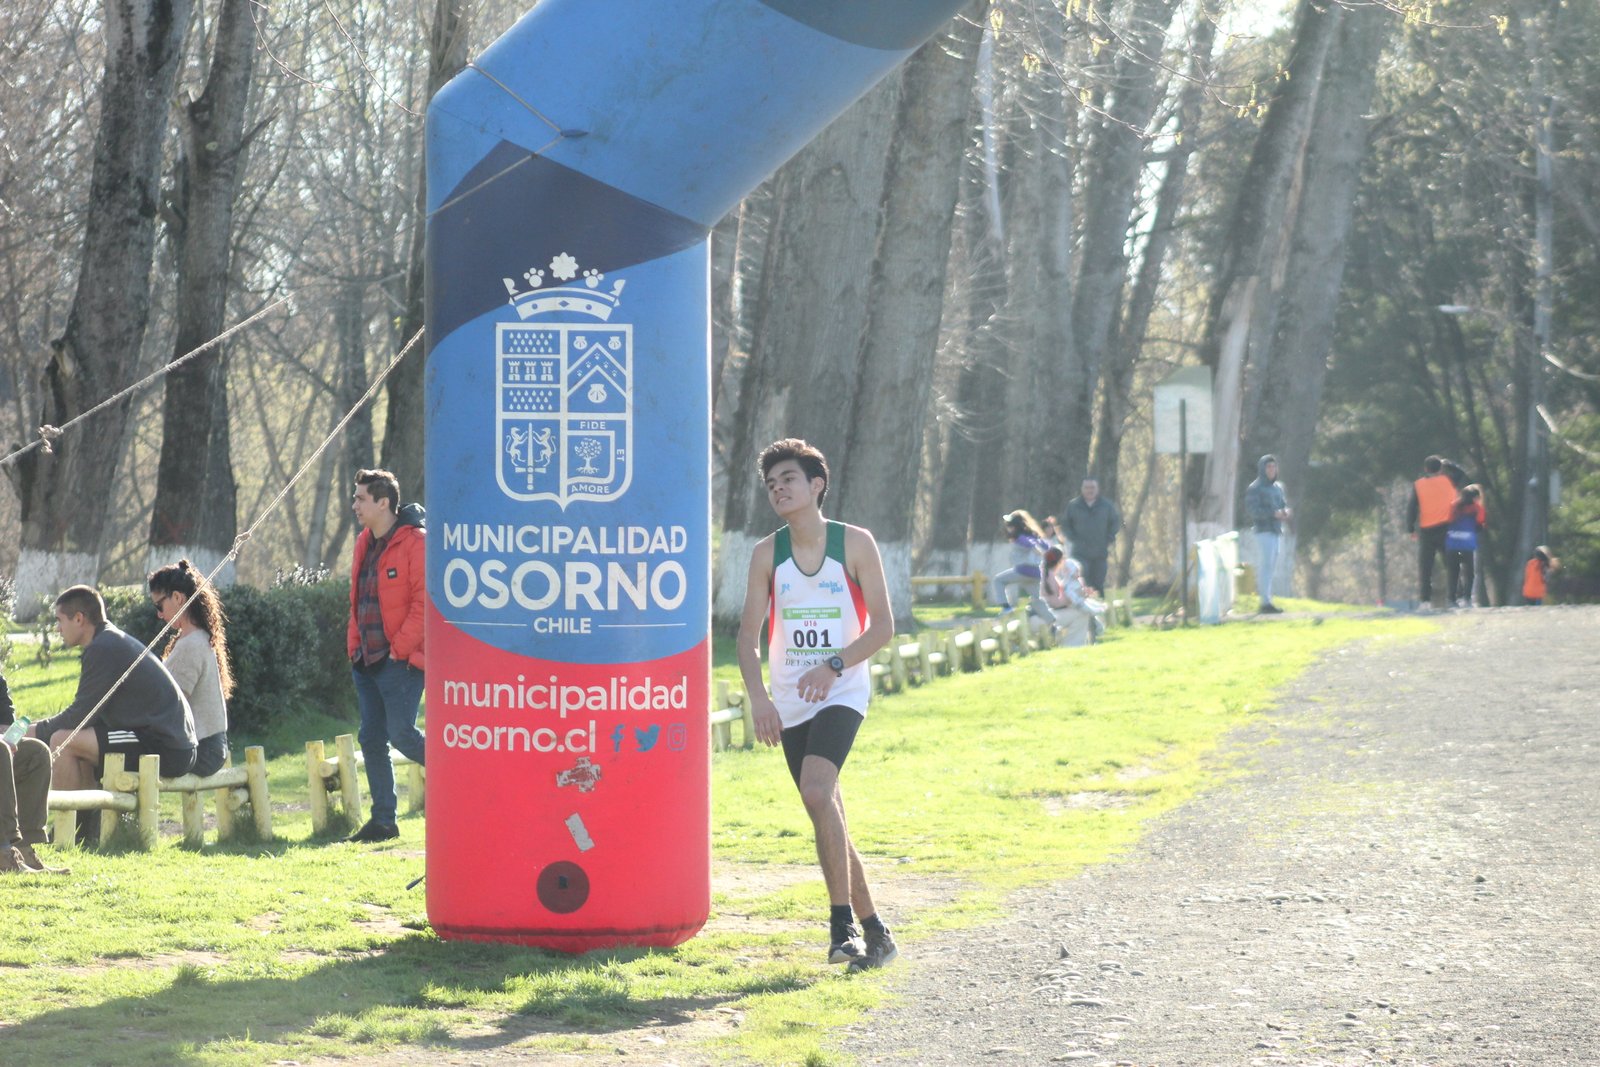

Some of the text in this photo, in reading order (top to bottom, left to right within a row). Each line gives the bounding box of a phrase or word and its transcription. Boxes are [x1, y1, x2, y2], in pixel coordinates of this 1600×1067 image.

[580, 421, 606, 430] FIDE
[616, 449, 625, 462] ET
[571, 484, 609, 493] AMORE
[443, 522, 687, 555] MUNICIPALIDAD
[443, 558, 687, 611] OSORNO
[533, 617, 592, 634] CHILE
[793, 629, 831, 648] 001
[443, 674, 687, 718] municipalidad
[443, 719, 596, 753] osorno.cl
